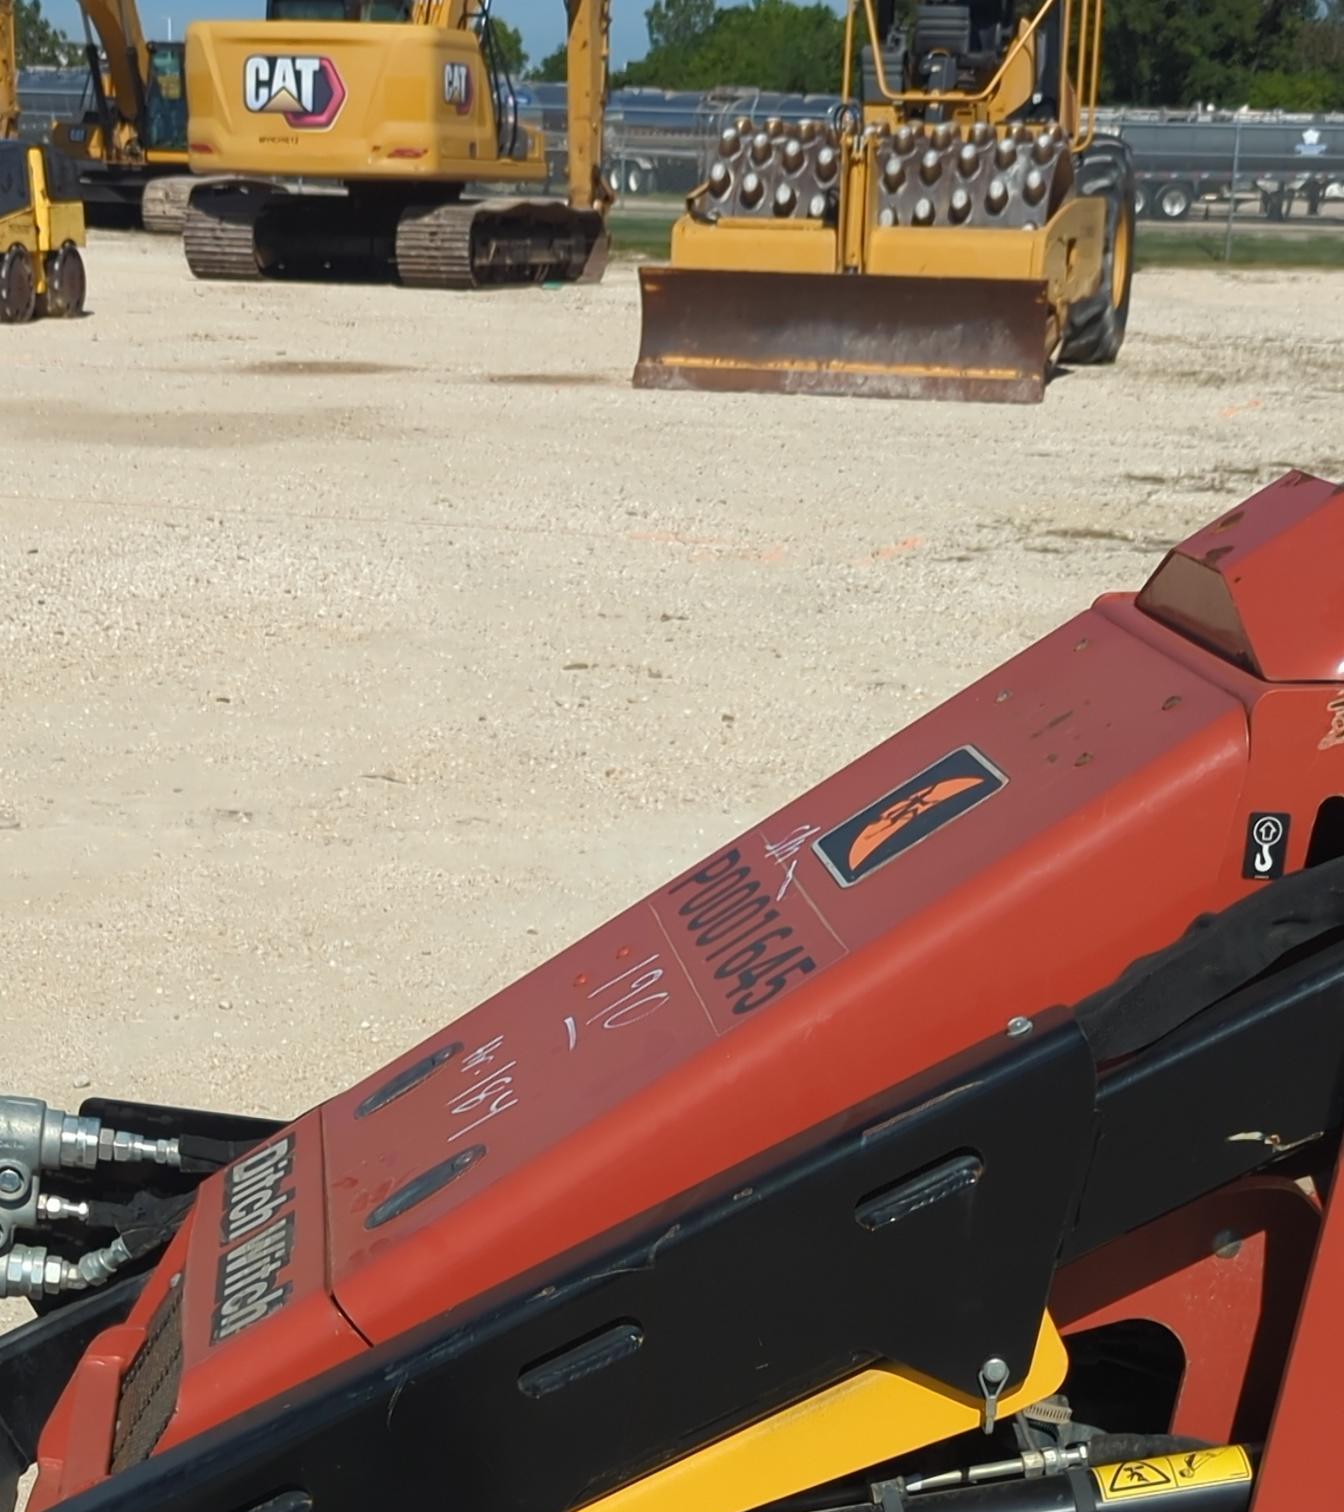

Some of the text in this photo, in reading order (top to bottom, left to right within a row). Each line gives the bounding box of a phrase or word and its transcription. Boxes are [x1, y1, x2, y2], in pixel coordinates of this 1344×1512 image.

[245, 56, 320, 113] CAT
[444, 63, 467, 103] CAT
[668, 848, 817, 1015] P0001645
[218, 1137, 289, 1339] Ditch Witch
